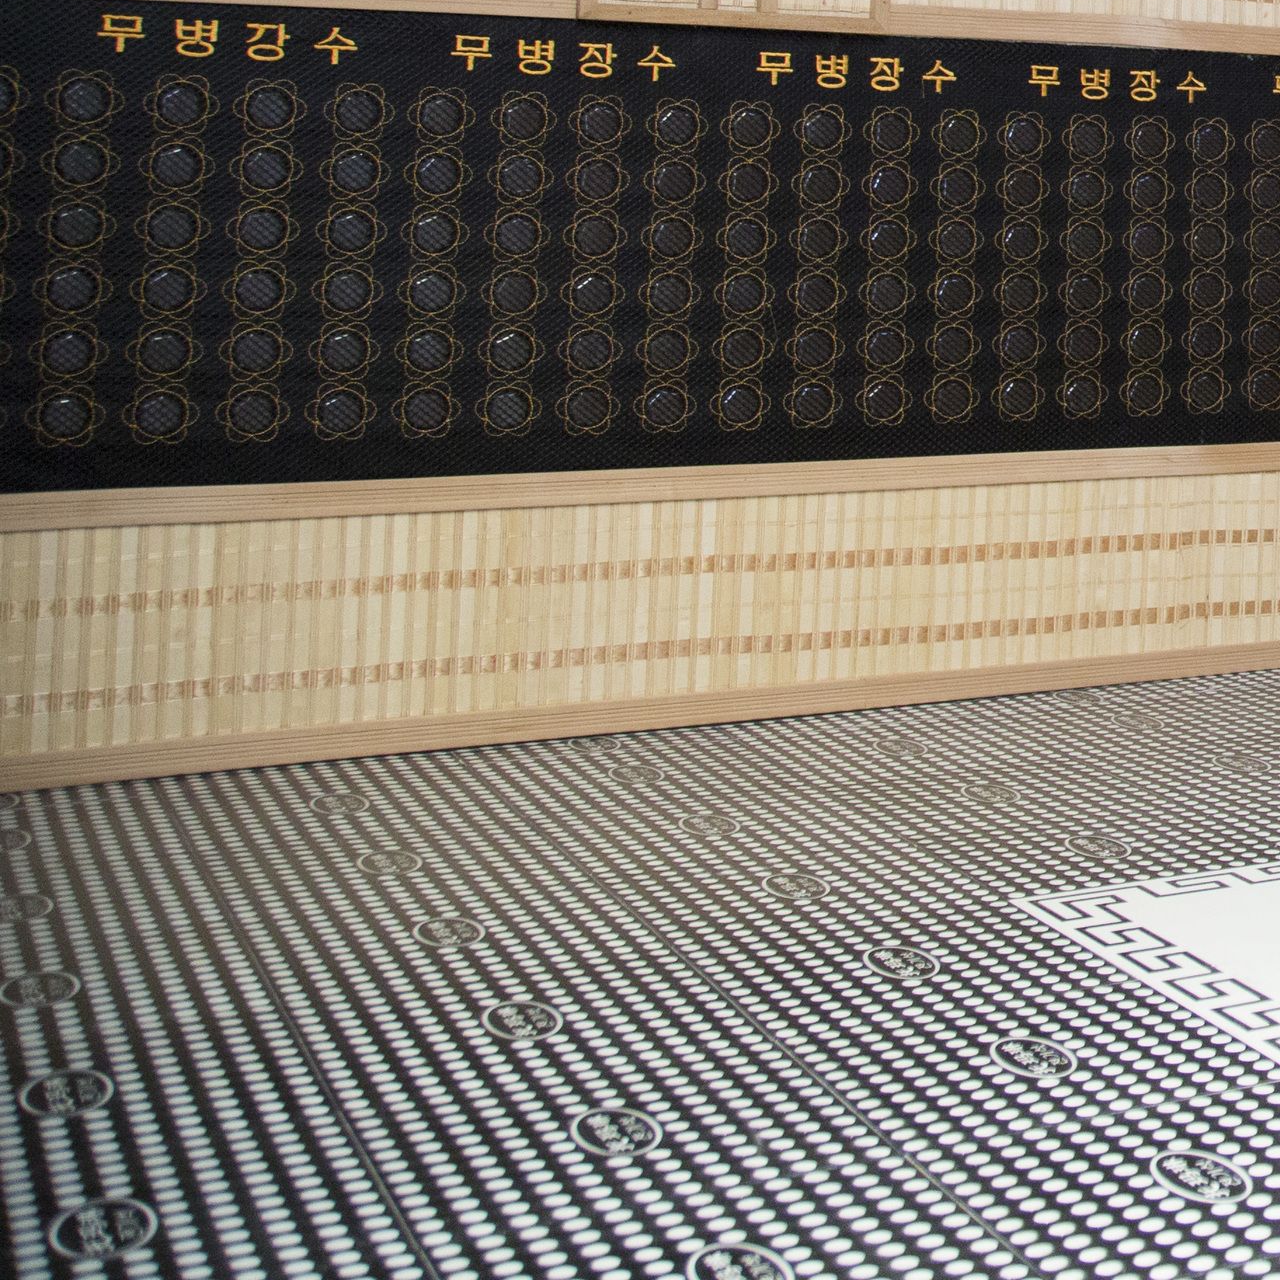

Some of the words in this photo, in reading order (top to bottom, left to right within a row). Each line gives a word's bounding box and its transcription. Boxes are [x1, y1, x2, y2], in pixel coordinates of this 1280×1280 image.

[450, 35, 675, 81] 무병장수
[756, 51, 956, 93] 무병장수
[1028, 65, 1206, 103] 무병장수
